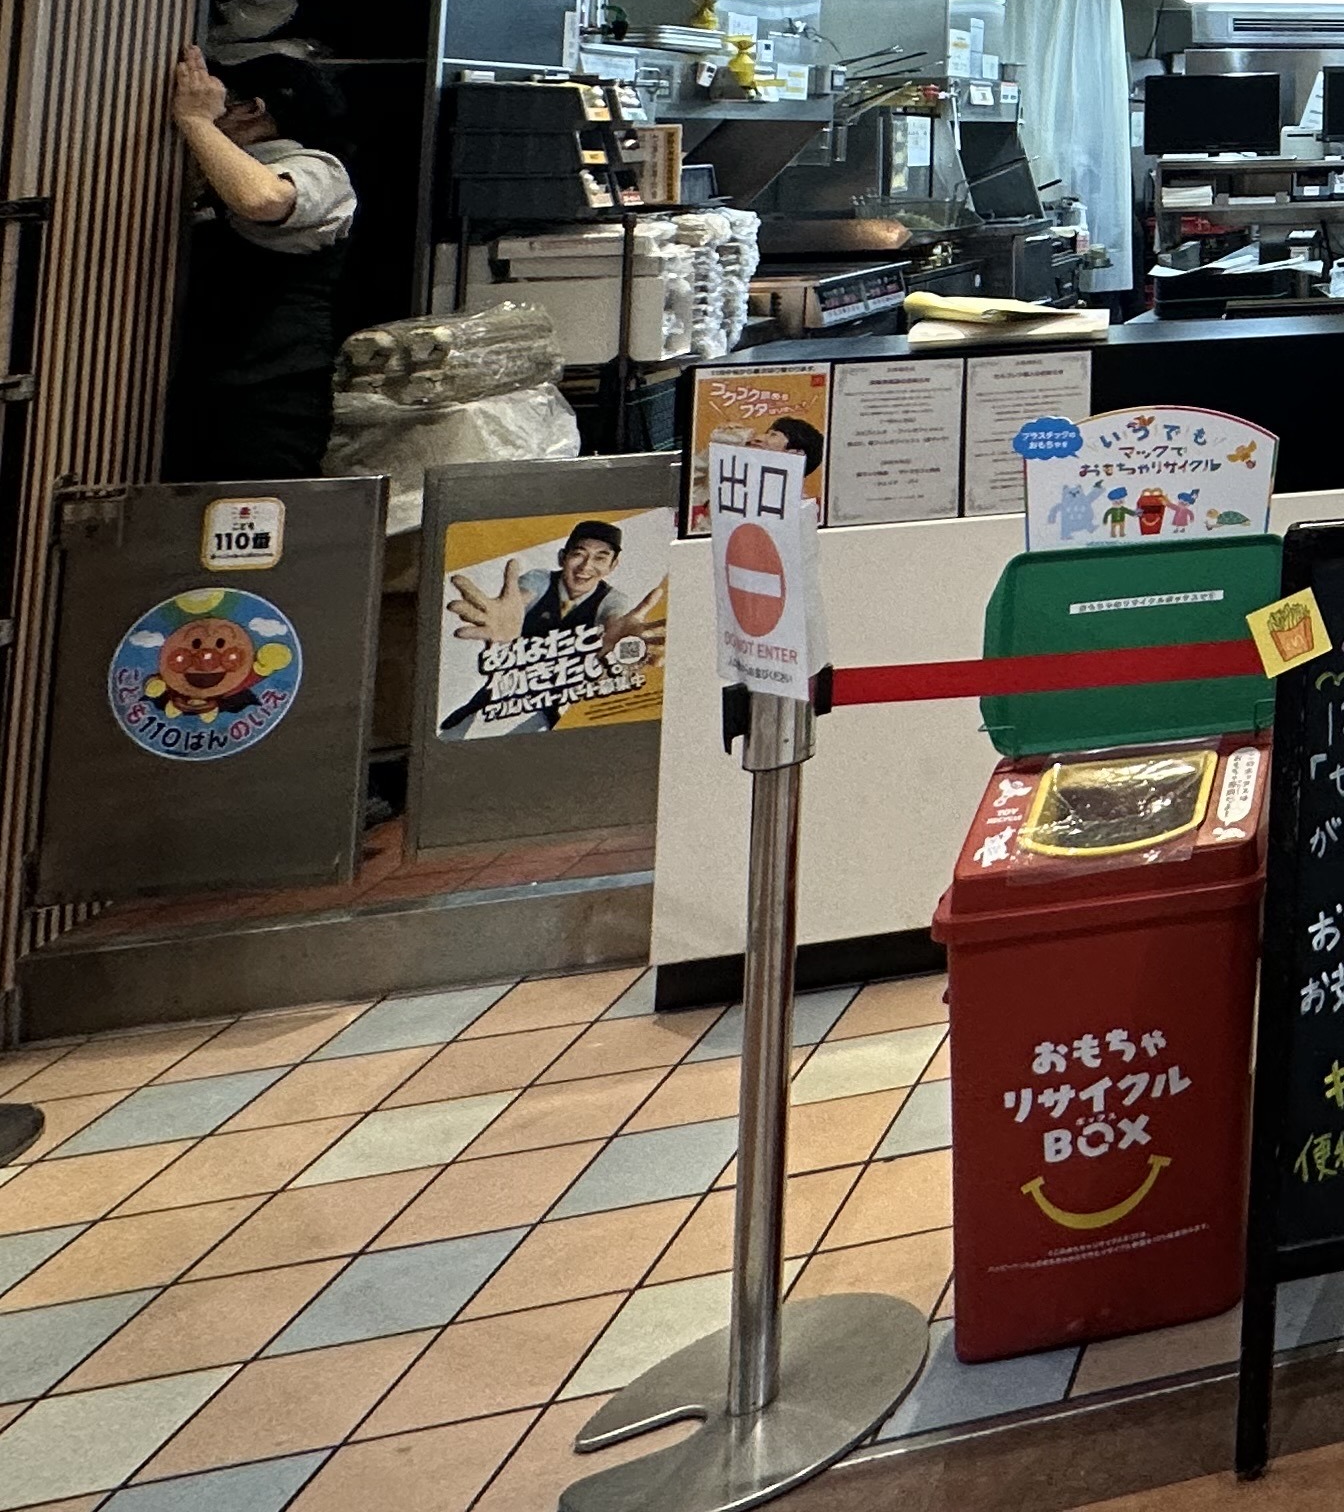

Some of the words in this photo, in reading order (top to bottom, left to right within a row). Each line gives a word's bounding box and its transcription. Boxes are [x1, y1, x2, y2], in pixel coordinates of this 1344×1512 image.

[1099, 423, 1208, 449] いつでも
[1118, 444, 1189, 459] マックで
[718, 454, 788, 520] 出口
[1078, 459, 1222, 478] おもちゃリサイクル
[214, 531, 271, 551] 110番
[481, 623, 605, 672] あなたと
[757, 641, 798, 665] ENTER
[1031, 1028, 1168, 1076] おもちゃ
[1003, 1065, 1193, 1124] リサイクル
[1043, 1113, 1153, 1164] BOX
